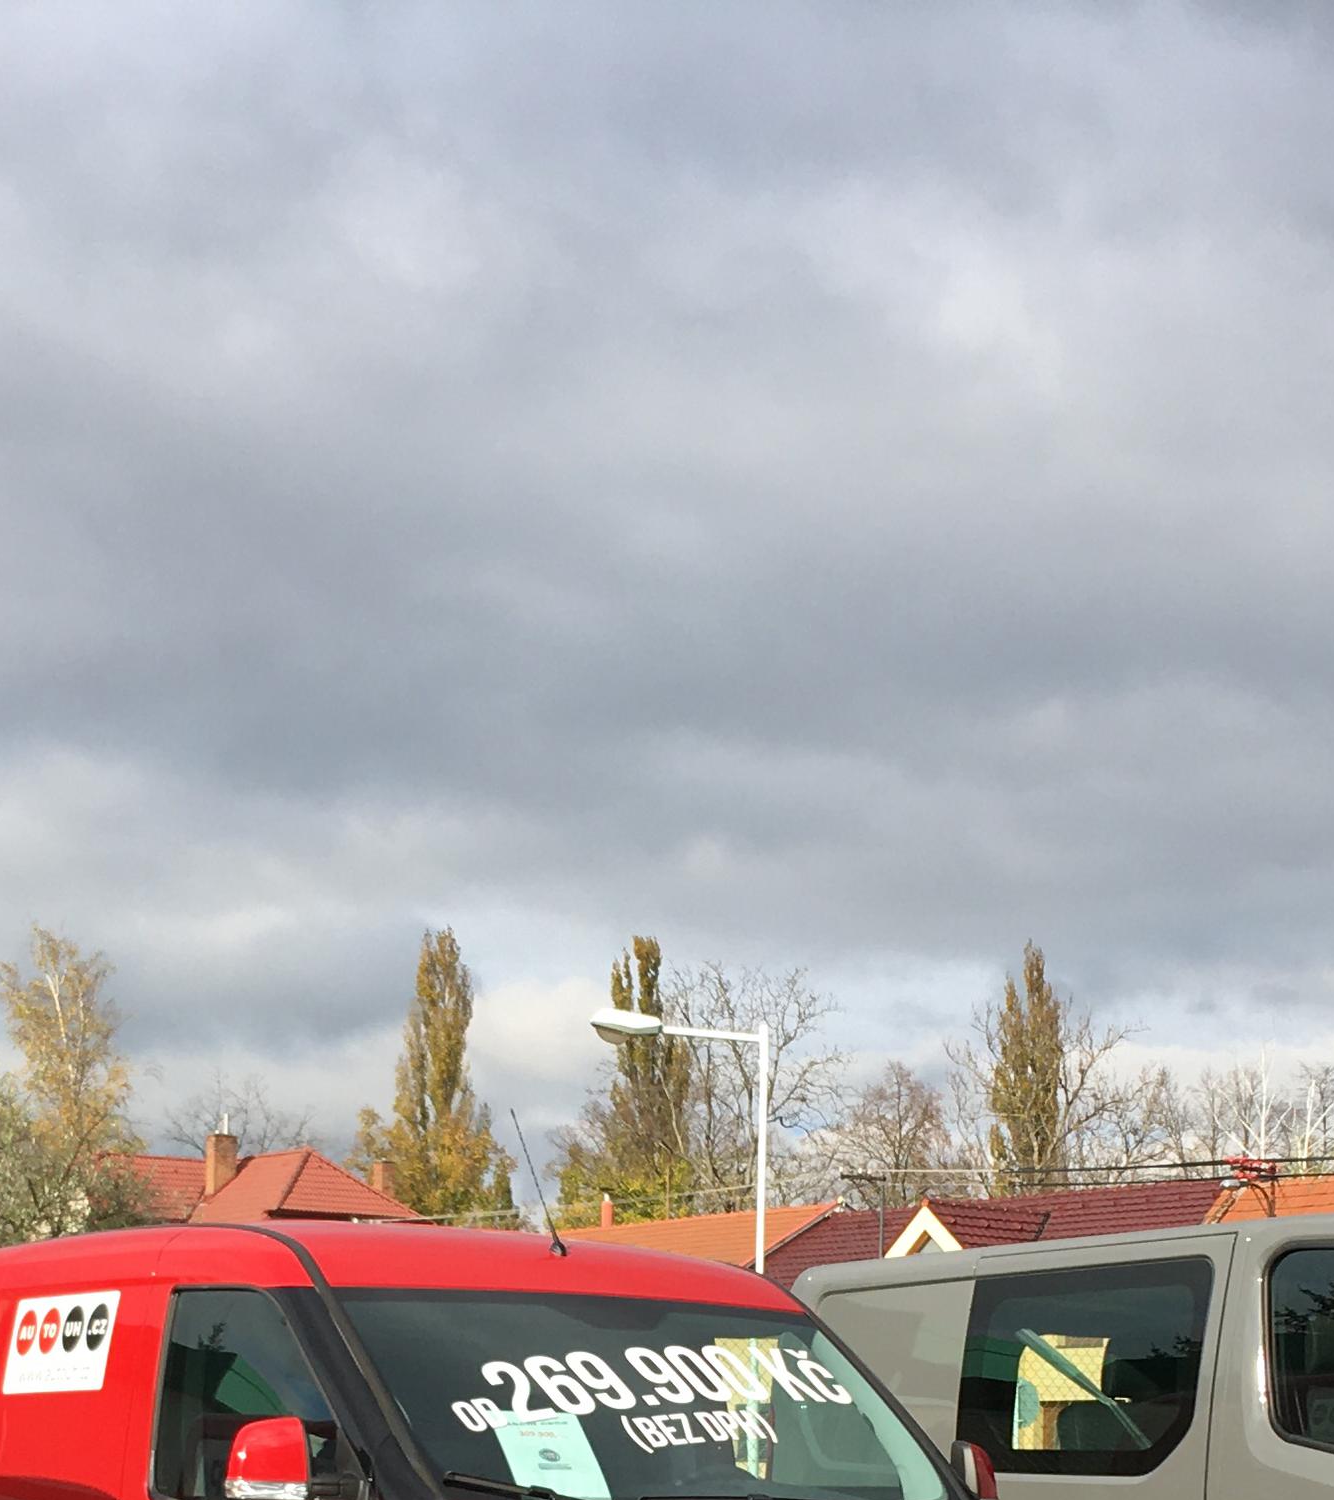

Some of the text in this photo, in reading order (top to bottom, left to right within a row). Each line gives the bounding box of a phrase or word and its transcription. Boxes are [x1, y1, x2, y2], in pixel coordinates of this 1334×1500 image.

[19, 1318, 108, 1341] AU TO UH .CZ
[451, 1345, 853, 1432] OD 269.900 Kč
[621, 1406, 778, 1454] (BEZ DPH)
